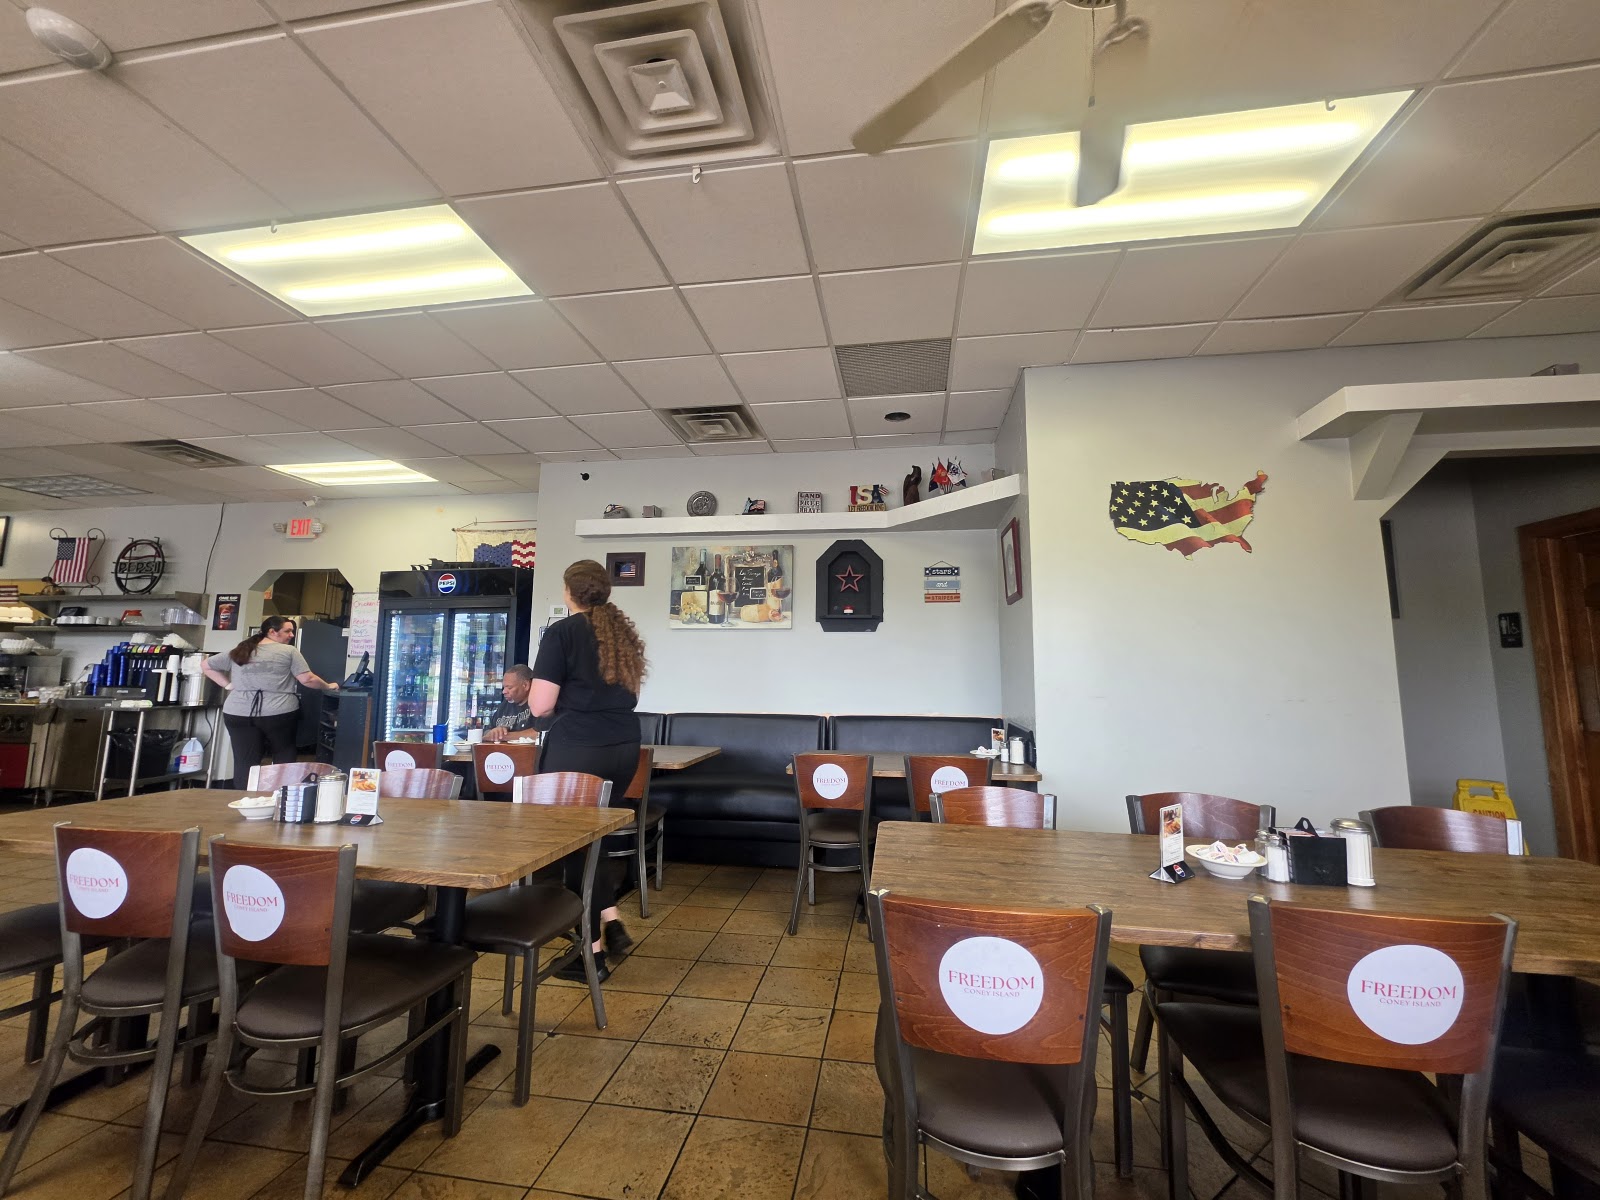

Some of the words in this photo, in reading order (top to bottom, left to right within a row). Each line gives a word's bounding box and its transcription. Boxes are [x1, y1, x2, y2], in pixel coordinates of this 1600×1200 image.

[290, 519, 312, 536] EXIT
[118, 561, 161, 574] PEPSI
[934, 779, 966, 787] FREEDOM
[69, 874, 119, 888] FREEDOM
[226, 891, 278, 907] FREEDOM
[948, 970, 1035, 990] FREEDOM
[963, 988, 990, 997] CONEY
[992, 990, 1020, 998] ISLAND
[1360, 979, 1457, 1000] FREEDOM
[1379, 998, 1410, 1007] CONEY
[1412, 1000, 1442, 1008] ISLAND
